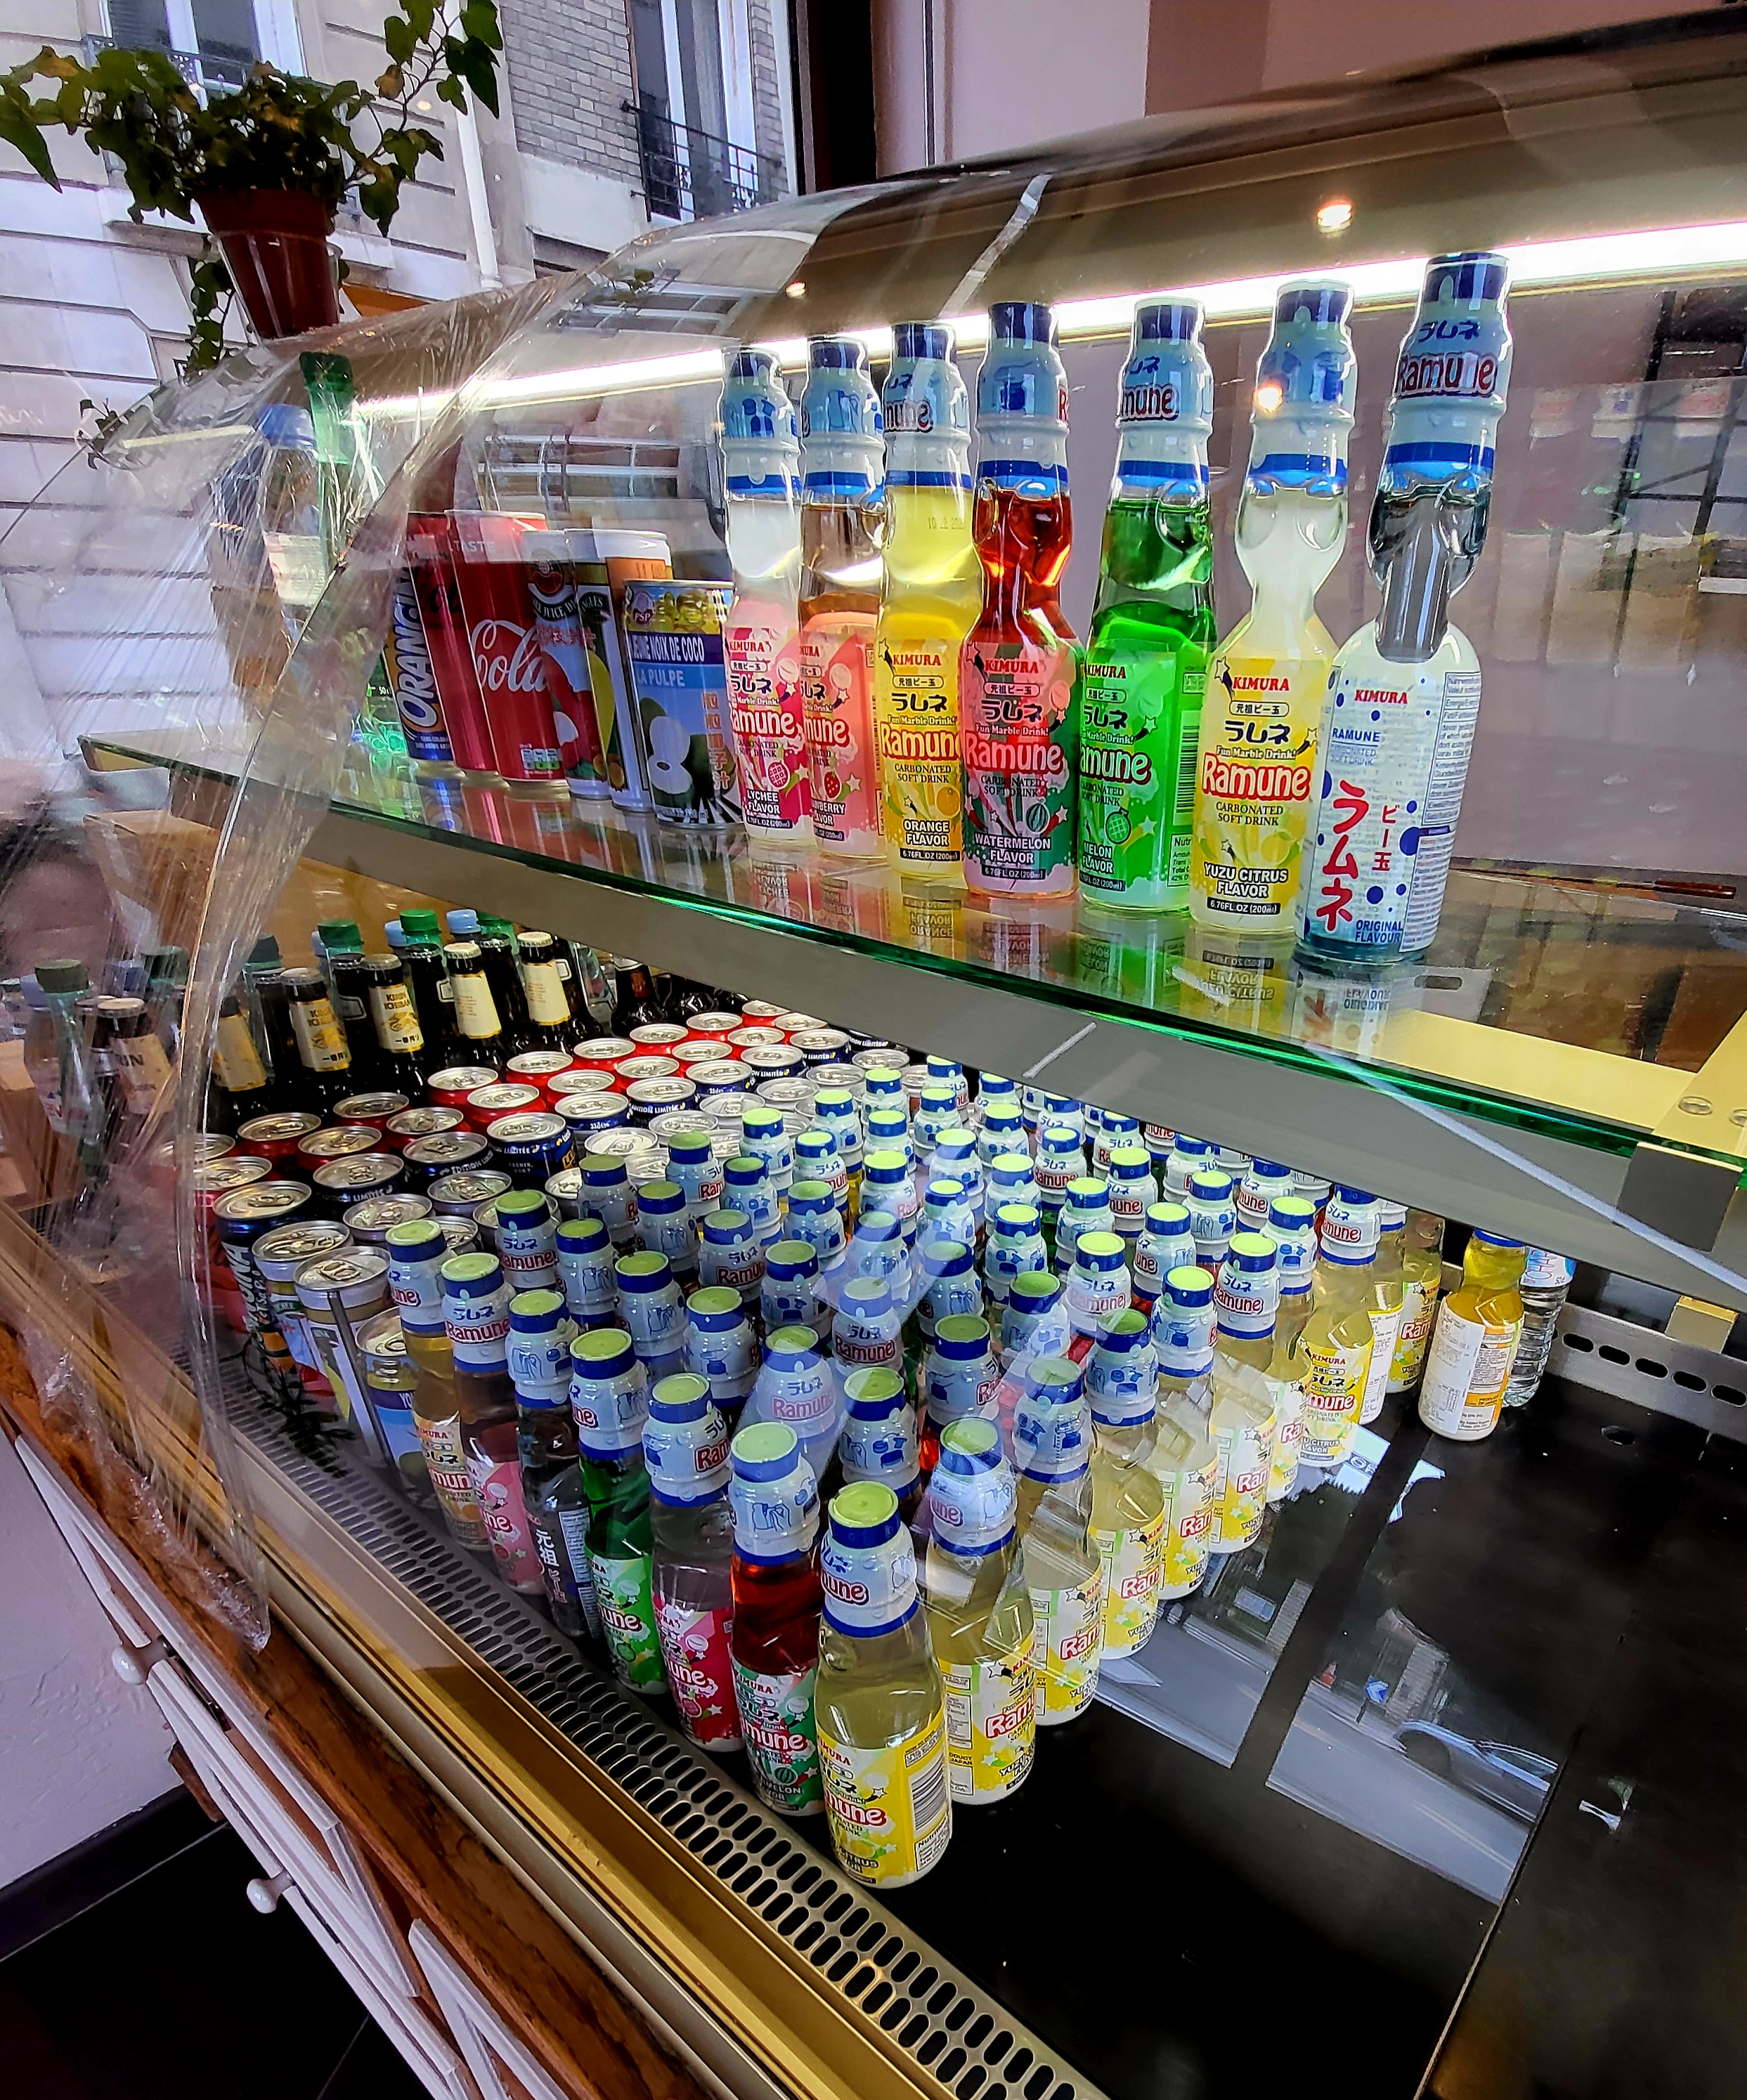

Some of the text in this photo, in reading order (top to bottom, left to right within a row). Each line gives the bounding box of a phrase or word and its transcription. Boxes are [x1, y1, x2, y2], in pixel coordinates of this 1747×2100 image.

[1420, 320, 1479, 341] ラムネ
[1398, 353, 1498, 396] Ramune
[1123, 385, 1178, 419] mune
[453, 540, 495, 553] TASTE
[635, 611, 651, 623] PSP
[650, 635, 668, 661] NOIX
[669, 637, 681, 661] DE
[682, 637, 705, 663] COCO
[729, 640, 765, 653] KIMURA
[800, 644, 820, 658] MURA
[892, 653, 942, 667] KIMURA
[985, 659, 1039, 674] KIMURA
[648, 670, 684, 687] PULPE
[1086, 664, 1126, 679] KIMURA
[729, 674, 772, 694] ラムネ
[898, 677, 936, 687] 元祖ビー玉
[1233, 677, 1290, 692] KIMURA
[990, 684, 1032, 696] 元祖ビー玉
[1354, 689, 1408, 704] KIMURA
[737, 695, 780, 706] Marble Drink!
[890, 692, 948, 712] ラムネ
[981, 698, 1043, 722] ラムネ
[1236, 703, 1280, 715] 元祖ビー玉
[888, 714, 956, 726] Fun Marble Drink!
[1082, 705, 1129, 729] ラムネ
[803, 718, 849, 745] mune
[976, 724, 1050, 736] Fun Marble Drink!
[1224, 720, 1290, 744] ラムネ
[1332, 728, 1380, 743] RAMUNE
[1107, 733, 1134, 745] Drink!
[753, 748, 777, 759] DRINK
[965, 736, 1063, 771] Ramune
[1216, 746, 1297, 759] Fun Marble Drink!
[895, 763, 952, 774] CARBONATED
[1080, 745, 1150, 782] amune
[897, 774, 949, 783] SOFT DRINK
[980, 775, 1041, 788] CARBONATED
[1203, 755, 1311, 799] Ramune
[747, 789, 779, 802] LYCHEE
[984, 785, 1039, 797] SOFT DRINK
[748, 801, 781, 815] FLAVOR
[1097, 795, 1121, 807] DRINK
[1216, 801, 1284, 815] CARBONATED
[904, 819, 951, 833] ORANGE
[1218, 813, 1279, 826] SOFT DRINK
[905, 832, 949, 847] FLAVOR
[975, 833, 1051, 850] WATERMELON
[1372, 804, 1400, 872] ビー玉
[989, 849, 1035, 864] FLAVOR
[1084, 842, 1112, 859] MELON
[1316, 780, 1369, 932] ラムネ
[1082, 856, 1114, 874] FLAVOR
[1204, 862, 1288, 882] YUZU CITRUS
[1216, 881, 1268, 899] FLAVOR
[1249, 902, 1278, 914] (200ml)
[1356, 920, 1404, 932] ORIGINAL
[1355, 931, 1401, 944] FLAVOUR
[1109, 1198, 1142, 1214] mune
[1238, 1192, 1266, 1213] mune
[1223, 1275, 1251, 1292] ラムネ
[1215, 1286, 1264, 1314] Ramune
[453, 1305, 495, 1321] ラムネ
[836, 1336, 895, 1362] Ramune
[1313, 1353, 1346, 1365] KIMURA
[1309, 1393, 1355, 1411] mune
[421, 1430, 448, 1440] MURA
[1302, 1444, 1328, 1454] LAVOR
[1313, 1439, 1339, 1447] CITRUS
[743, 1723, 805, 1750] mune
[826, 1796, 884, 1825] mune
